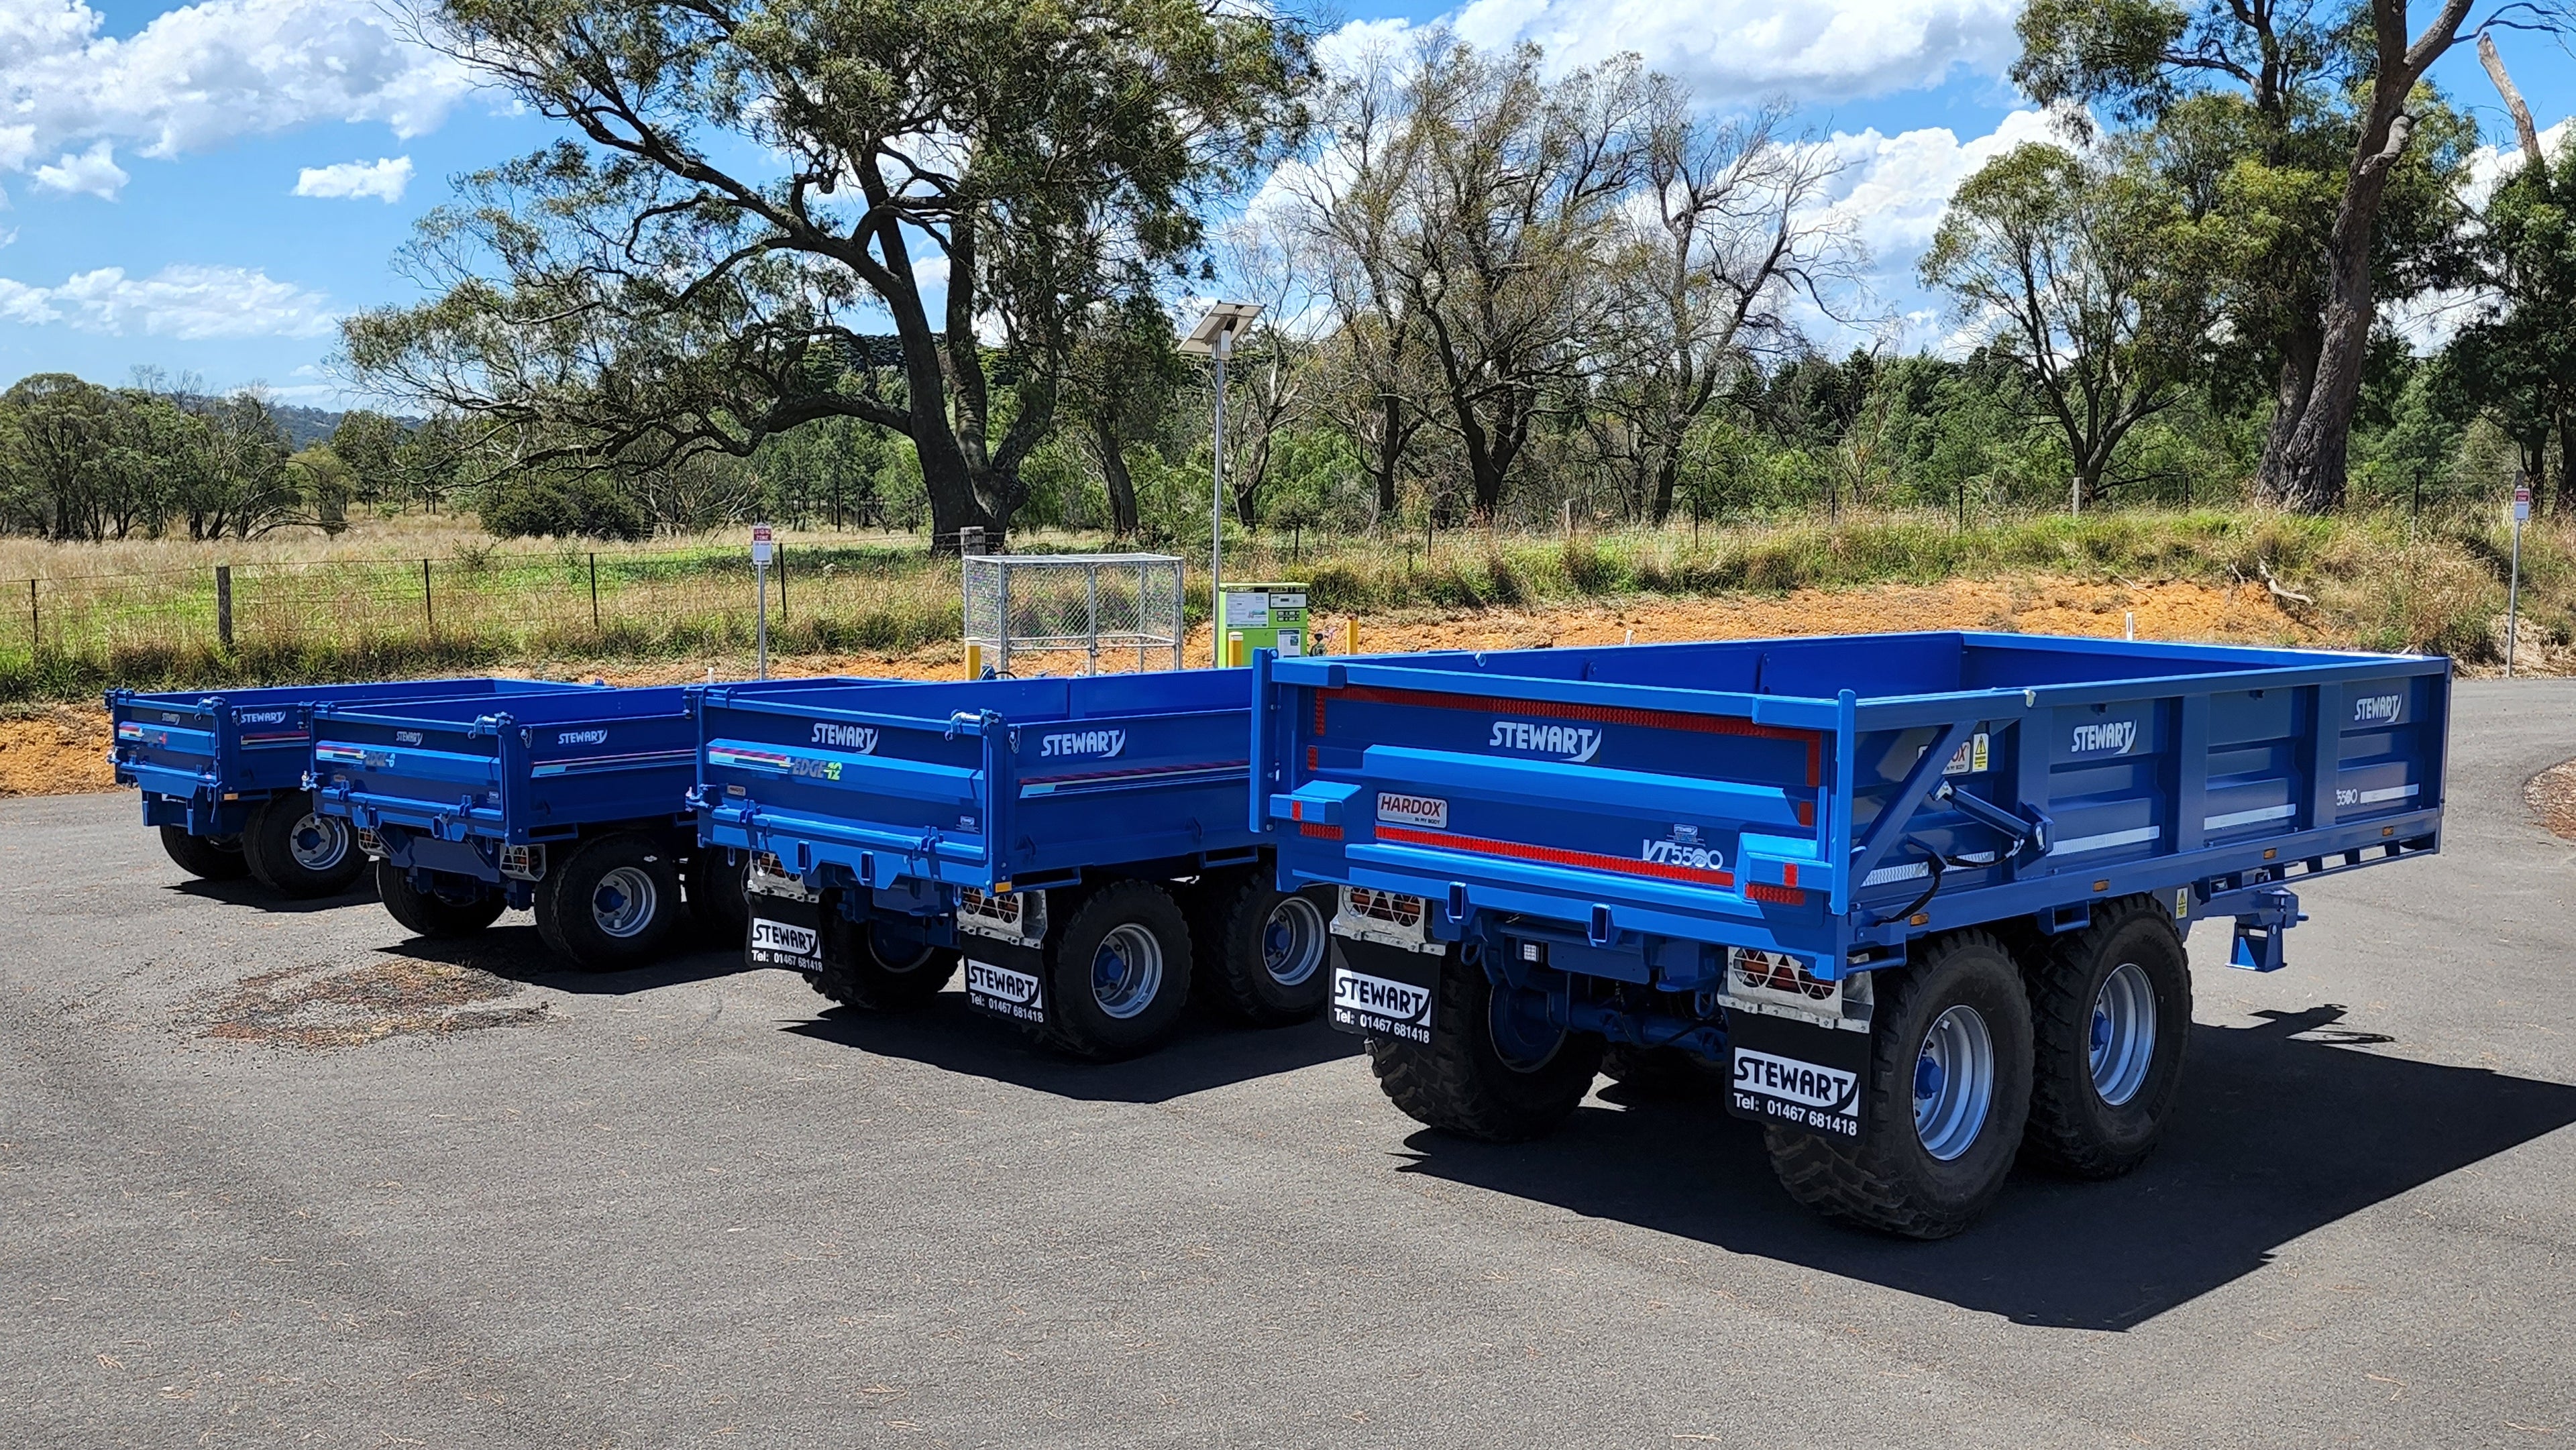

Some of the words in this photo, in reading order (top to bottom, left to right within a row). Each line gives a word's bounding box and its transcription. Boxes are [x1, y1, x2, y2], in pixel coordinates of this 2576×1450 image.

[241, 712, 286, 724] STEWART
[2354, 693, 2402, 724] STEWART
[396, 731, 423, 746] STEWART
[557, 729, 608, 744] STEWART
[811, 722, 879, 755] STEWART
[1040, 728, 1126, 758] STEWART
[1489, 721, 1602, 763] STEWART
[2071, 719, 2137, 755] STEWART
[1381, 795, 1442, 817] HARDOX
[751, 950, 769, 962] Tel:
[752, 924, 818, 958] STEWART
[969, 966, 1040, 1006] STEWART
[1335, 977, 1432, 1025] STEWART
[970, 992, 985, 1007] Tel:
[1013, 1005, 1044, 1023] 681418
[1334, 1007, 1356, 1025] Tel:
[1359, 1013, 1392, 1033] 01467
[1393, 1021, 1430, 1044] 681418
[1734, 1056, 1859, 1113] STEWART
[1733, 1093, 1760, 1112] Tel:
[1767, 1099, 1806, 1123] 01467
[1809, 1110, 1858, 1136] 681418
